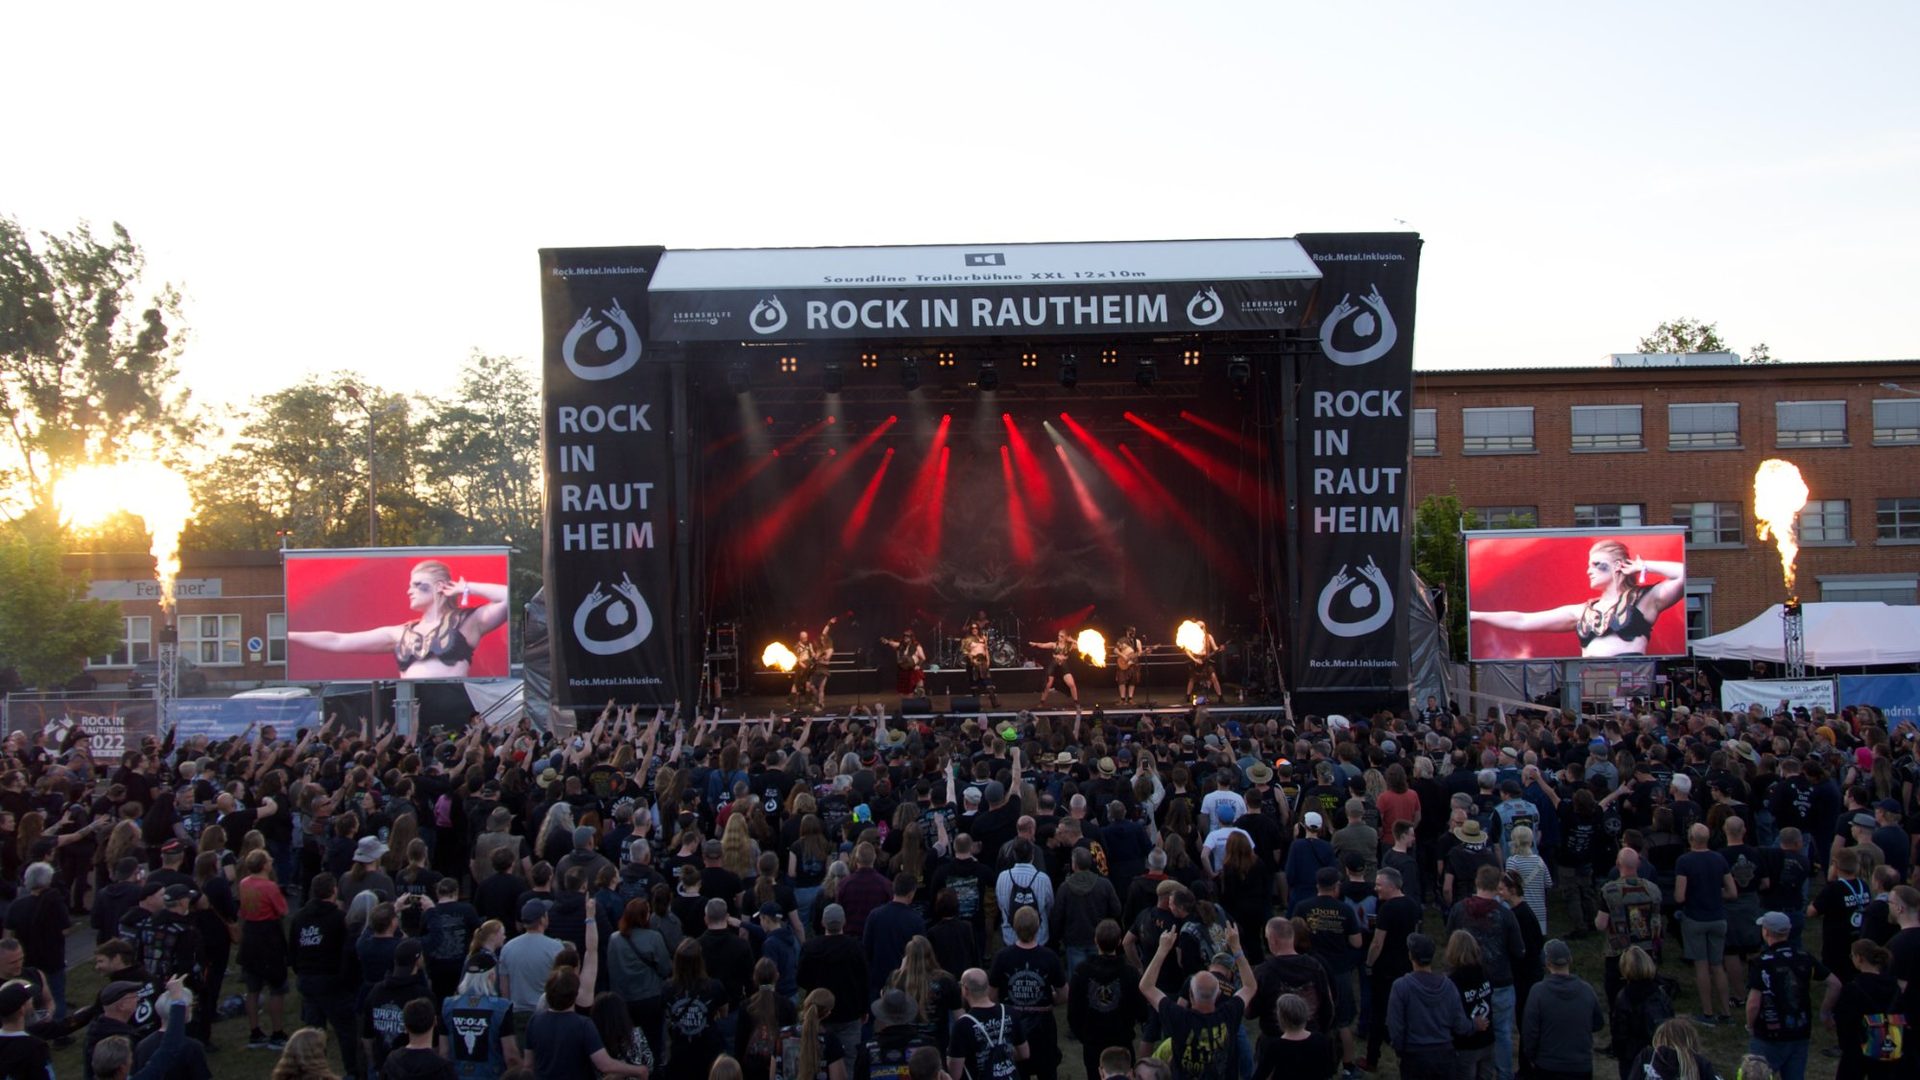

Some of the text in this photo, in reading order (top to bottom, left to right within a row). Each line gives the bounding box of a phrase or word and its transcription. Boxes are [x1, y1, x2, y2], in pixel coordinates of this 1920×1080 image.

[1312, 252, 1406, 262] Rock.Metal.Inklusion.
[552, 266, 648, 276] Rock.Metal.Inklusion.
[823, 270, 1146, 283] Soundline Trailerbühne XXL 12x10m
[806, 294, 1168, 330] ROCK IN RAUTHEIM
[1241, 300, 1297, 308] LEBENSHILFE
[673, 311, 731, 319] LEBENSHILFE
[1313, 390, 1403, 418] ROCK
[558, 404, 652, 434] ROCK
[1313, 429, 1349, 456] IN
[559, 445, 595, 473] IN
[1313, 467, 1401, 495] RAUT
[561, 482, 654, 512] RAUT
[1313, 506, 1400, 533] HEIM
[562, 521, 655, 551] HEIM
[1309, 659, 1399, 668] Rock.Metal.Inklusion.
[568, 676, 663, 686] Rock.Metal.Inklusion.
[81, 716, 125, 726] ROCK IN
[1881, 706, 1916, 718] ndrin.
